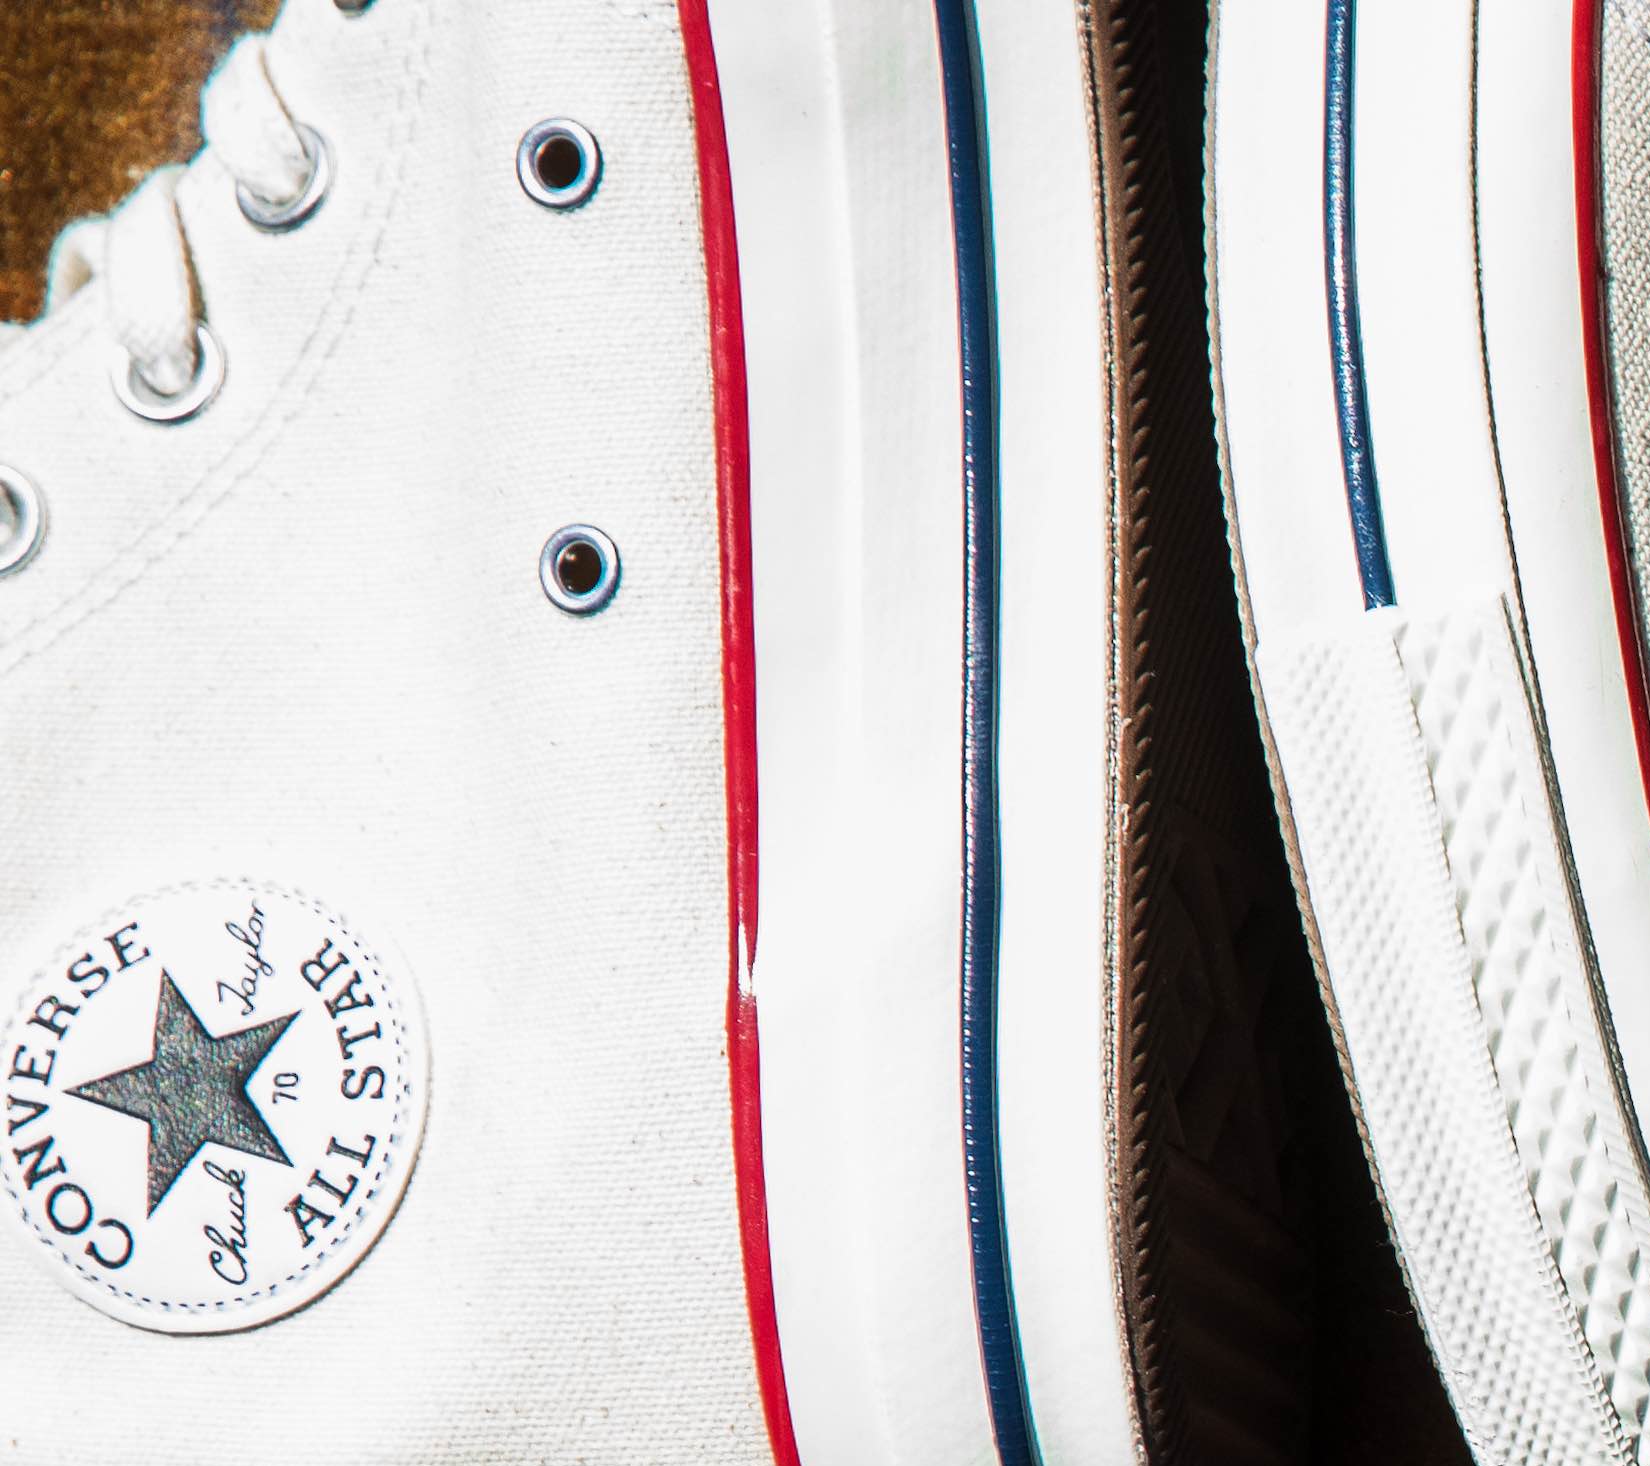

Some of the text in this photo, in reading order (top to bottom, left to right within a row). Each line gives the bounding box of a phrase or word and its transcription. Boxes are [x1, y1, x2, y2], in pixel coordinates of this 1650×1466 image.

[7, 922, 151, 1270] CONVERSE
[203, 899, 274, 1285] Chuck Taylor
[272, 1072, 299, 1104] 70
[284, 938, 385, 1248] ALL STAR
